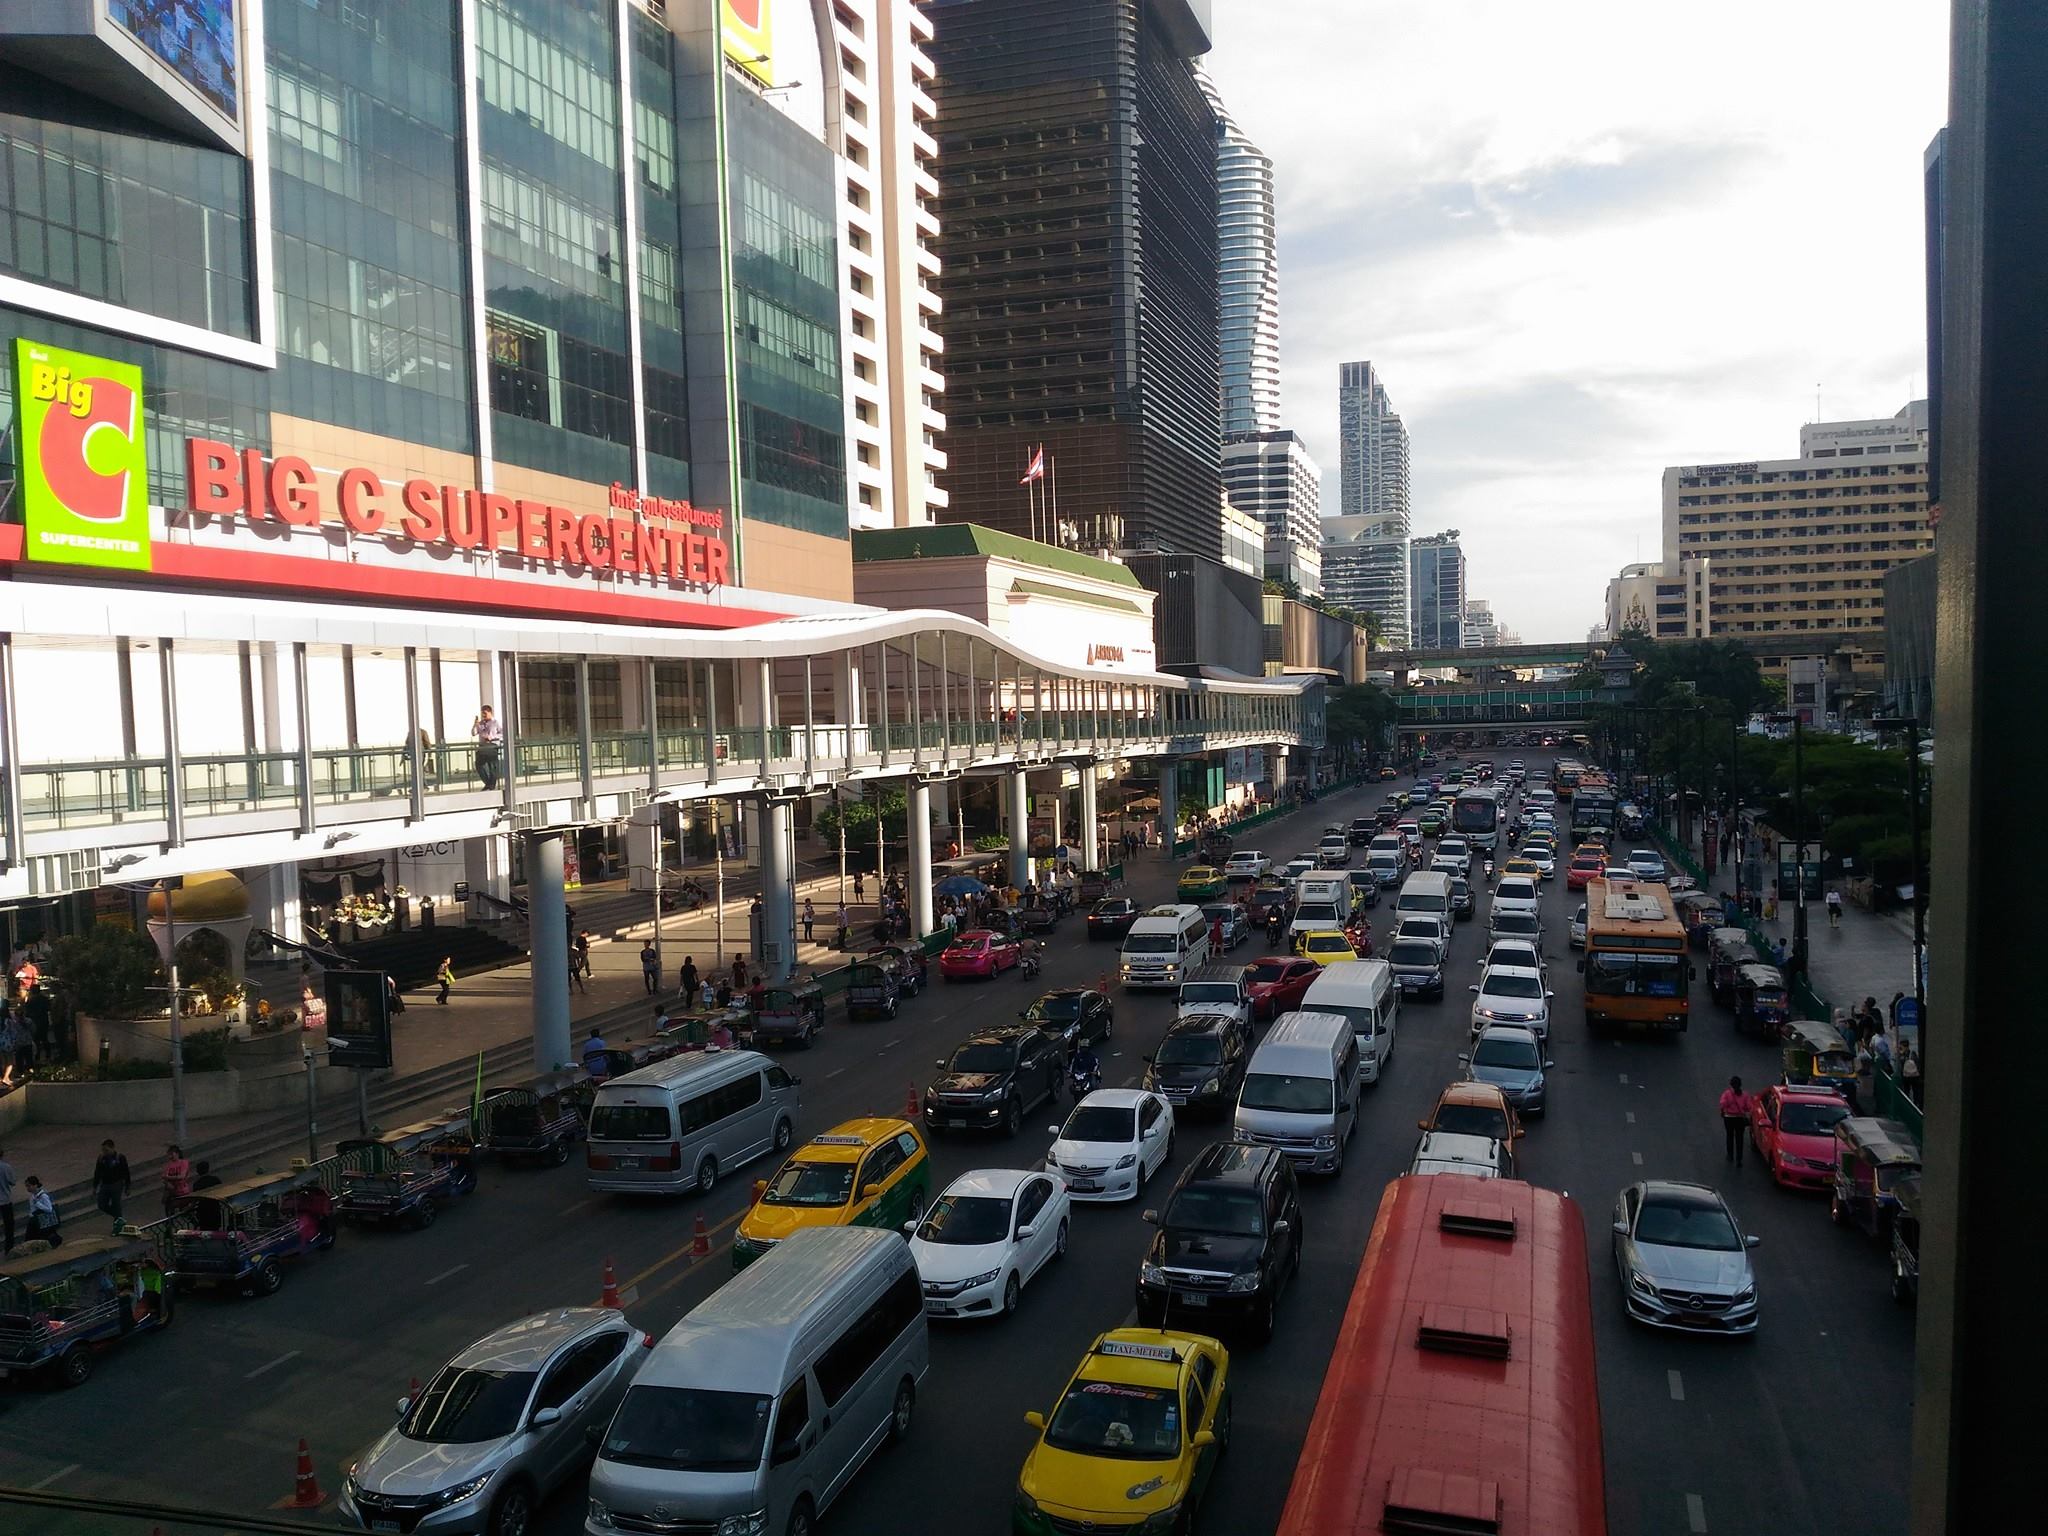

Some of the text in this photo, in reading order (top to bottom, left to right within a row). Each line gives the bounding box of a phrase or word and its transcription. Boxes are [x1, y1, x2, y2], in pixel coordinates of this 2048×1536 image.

[31, 363, 93, 418] Big
[186, 437, 730, 585] BIG C SUPERCENTER
[40, 531, 140, 553] SUPERCENTER
[1112, 1343, 1164, 1358] TAXI-METER
